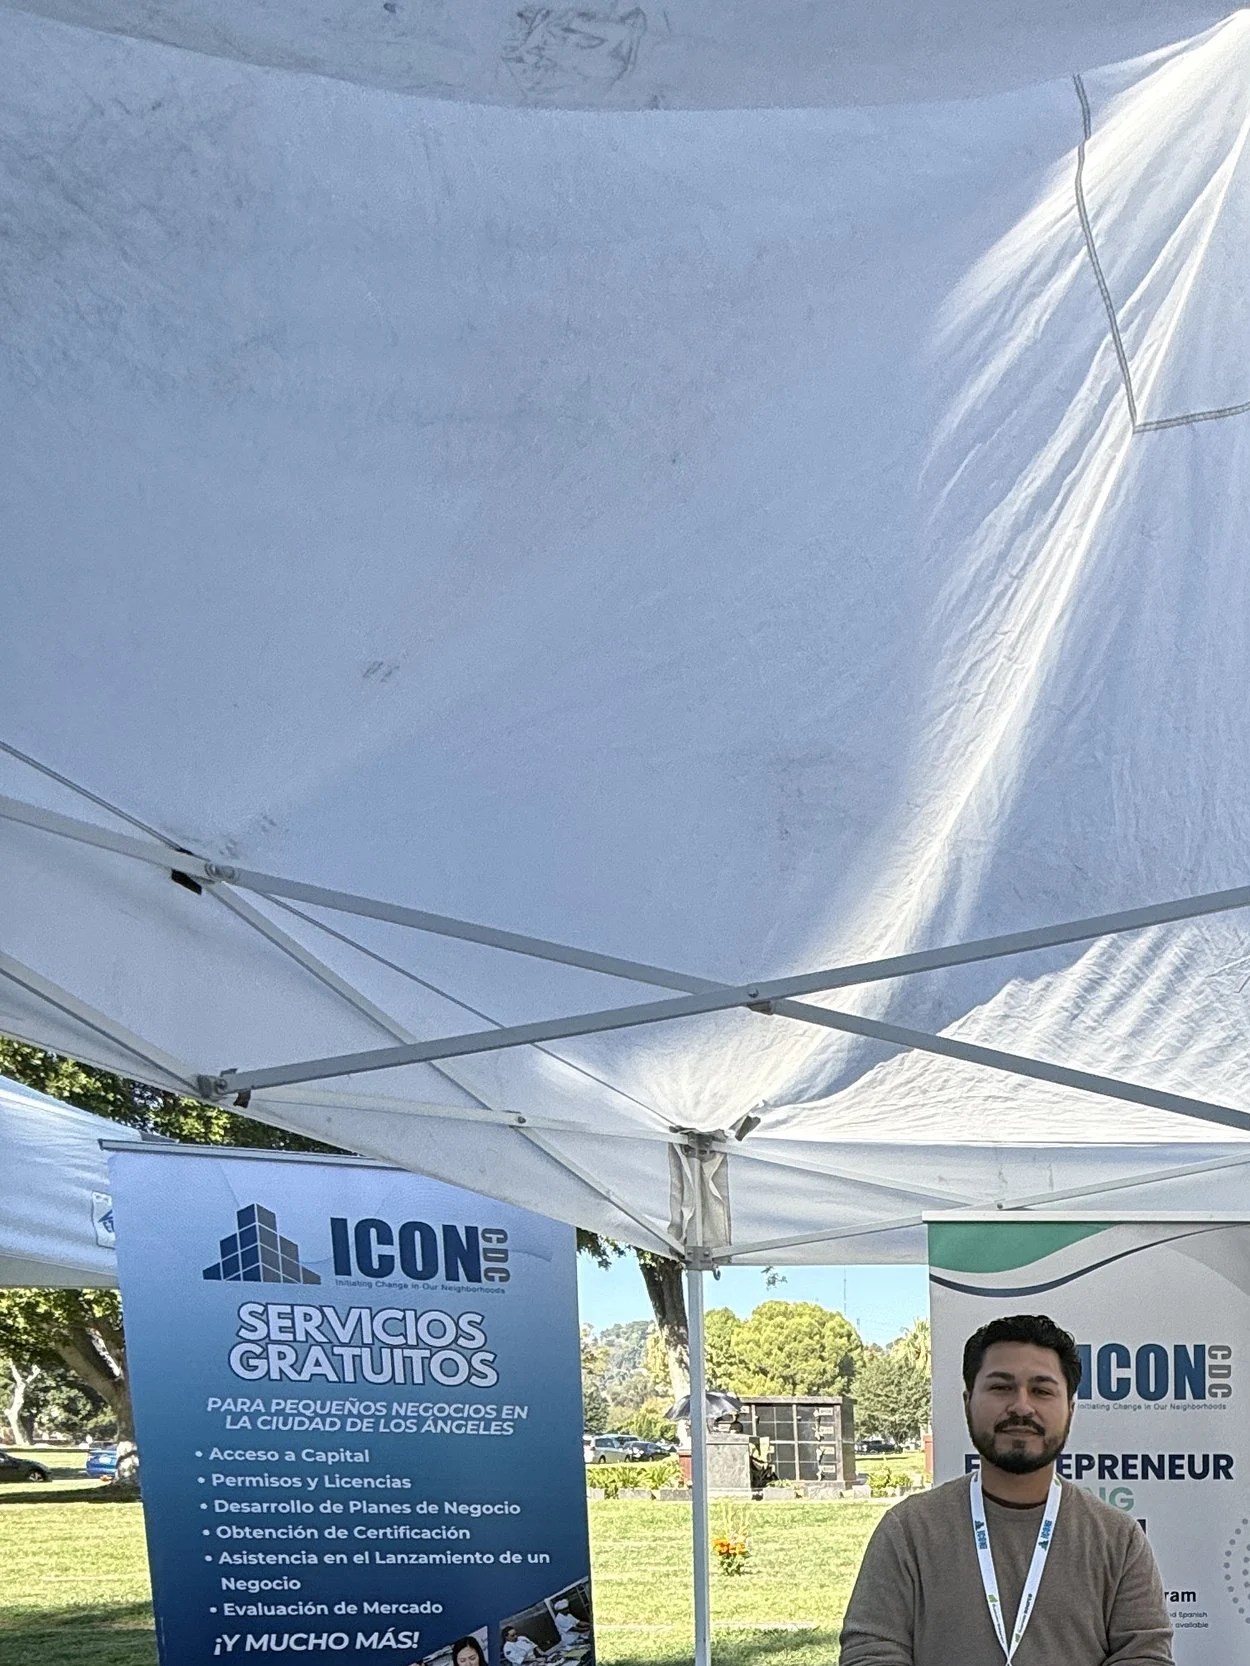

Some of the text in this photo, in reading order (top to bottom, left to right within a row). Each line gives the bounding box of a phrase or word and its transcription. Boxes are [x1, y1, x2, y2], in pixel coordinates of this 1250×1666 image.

[330, 1217, 511, 1283] ICON CDC
[237, 1302, 487, 1349] SERVICIOS
[229, 1344, 499, 1387] GRATUITOS
[1076, 1343, 1232, 1401] ICON CDC
[206, 1397, 528, 1419] PARA PEQUEÑOS NEGOCIOS EN
[225, 1415, 514, 1435] LA CIUDAD DE LOS ÁNGELES
[209, 1448, 370, 1465] Acceso a Capital
[965, 1454, 1234, 1480] EEPRENEUR
[211, 1474, 412, 1491] Permisos y Licencias
[214, 1500, 521, 1518] Desarrollo de Planes de Negocio
[216, 1525, 470, 1540] Obtención de Certificación
[218, 1551, 550, 1565] Asistencia en el Lanzamiento de un
[221, 1577, 301, 1593] Negocio
[224, 1601, 443, 1617] Evaluación de Mercado
[213, 1630, 420, 1656] ¡Y MUCHO MÁS!
